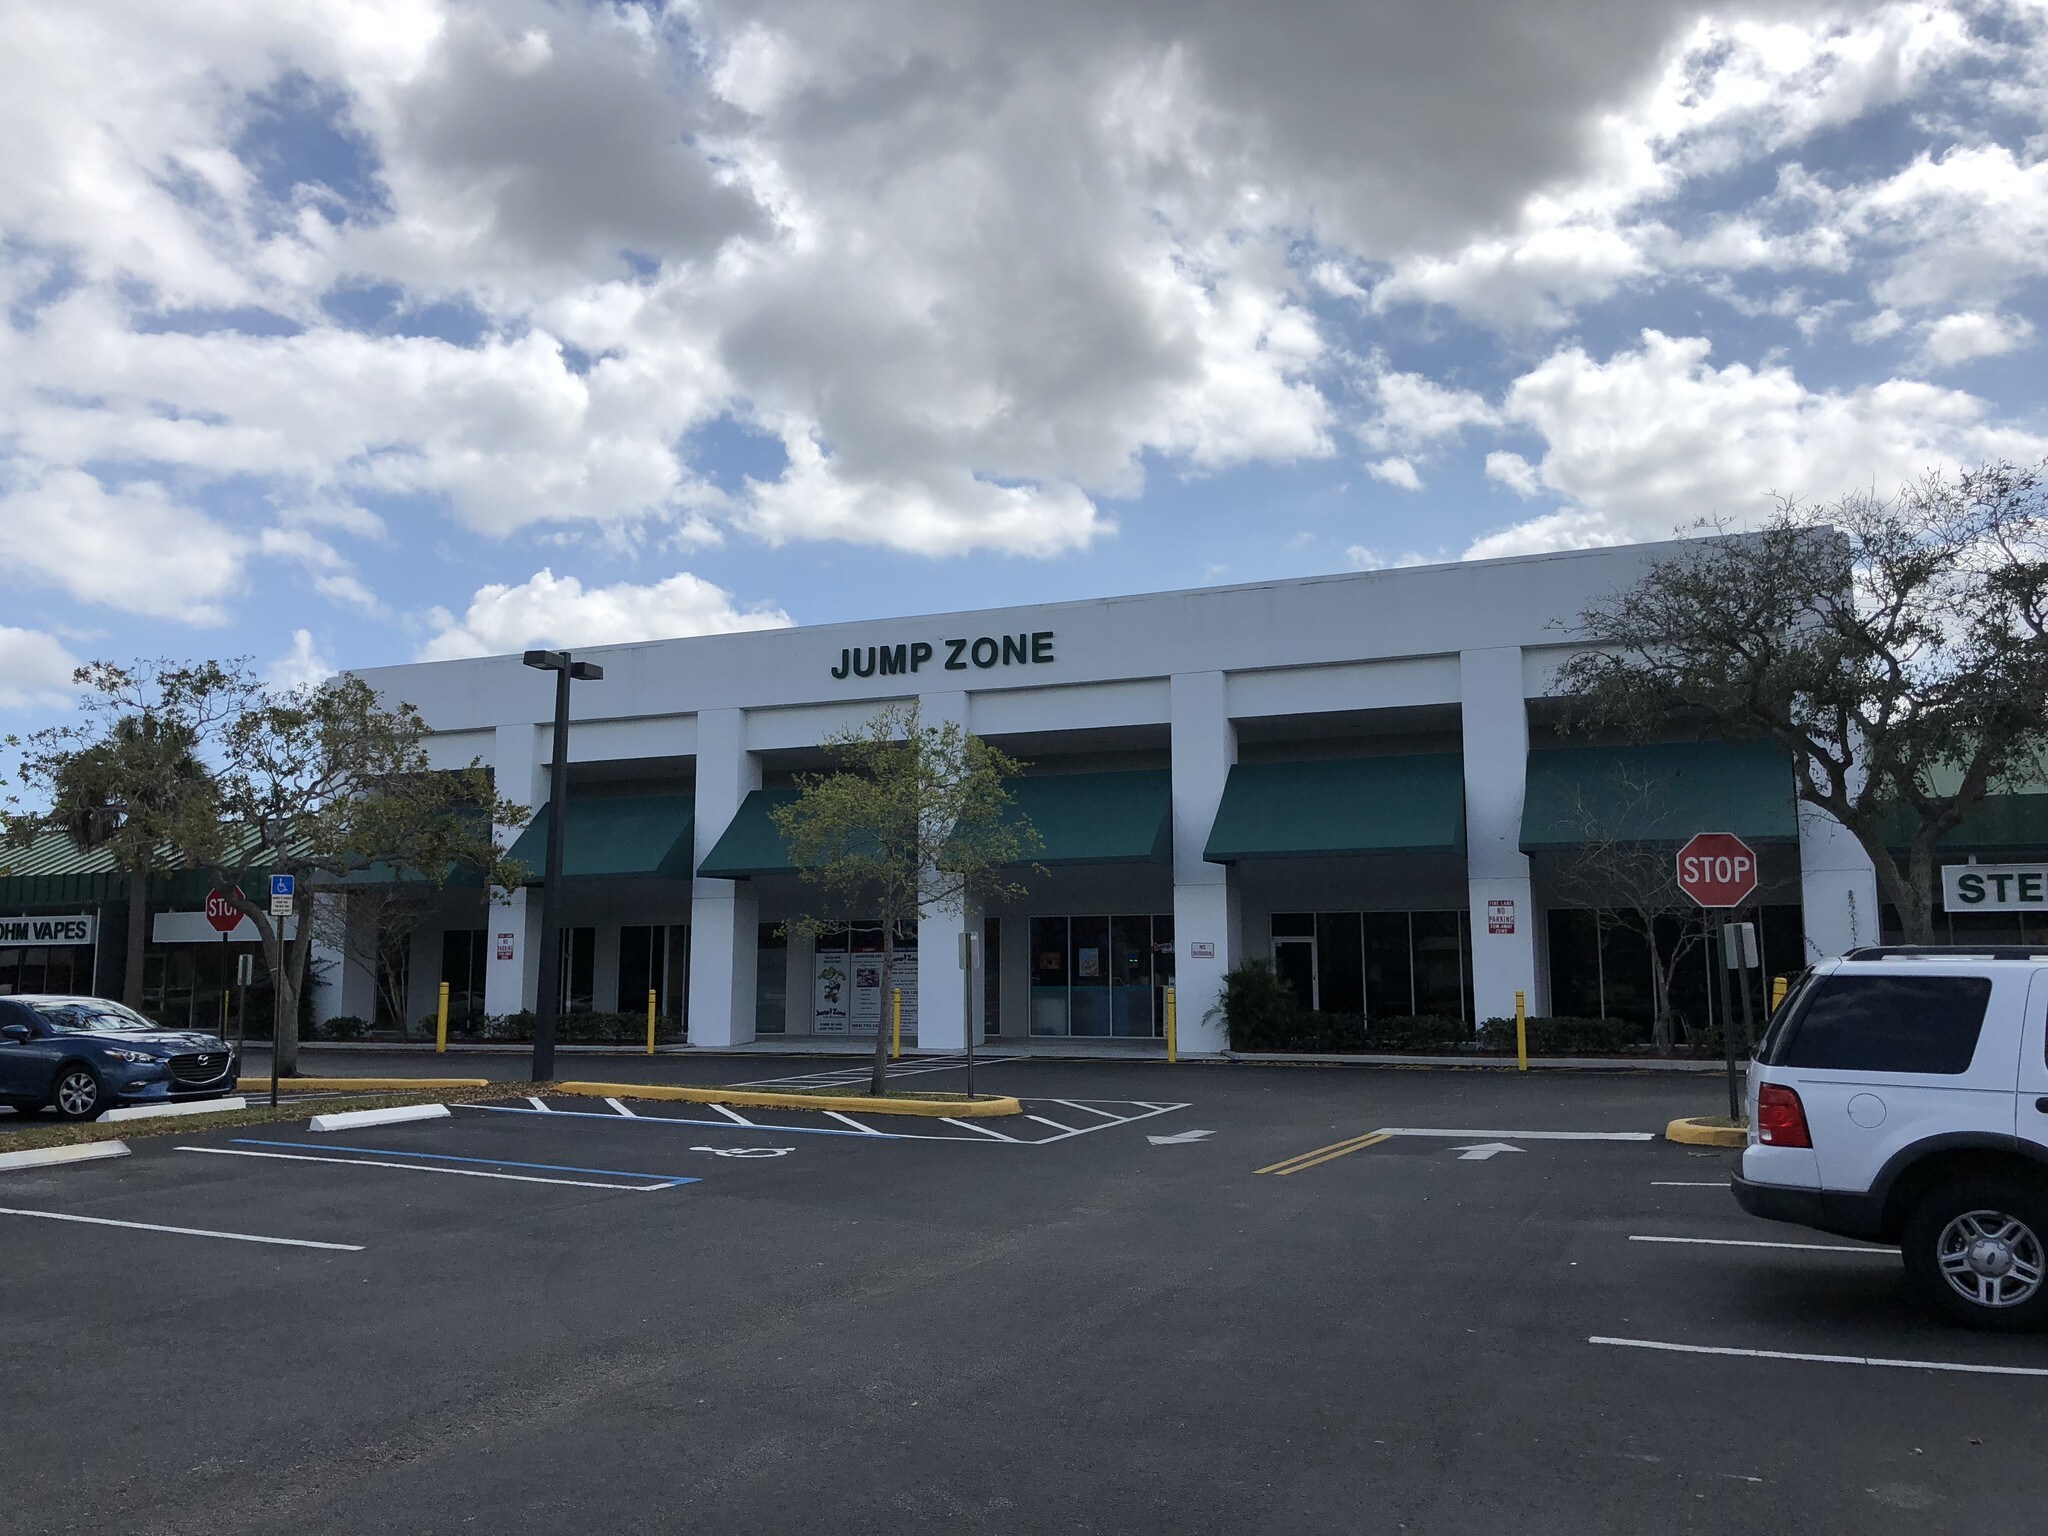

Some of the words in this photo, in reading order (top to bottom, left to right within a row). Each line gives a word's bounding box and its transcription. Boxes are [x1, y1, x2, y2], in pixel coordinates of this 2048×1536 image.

[831, 642, 933, 680] JUMP
[944, 631, 1054, 671] ZONE
[1683, 856, 1750, 883] STOP
[1958, 873, 2048, 904] STE
[33, 921, 87, 940] VAPES
